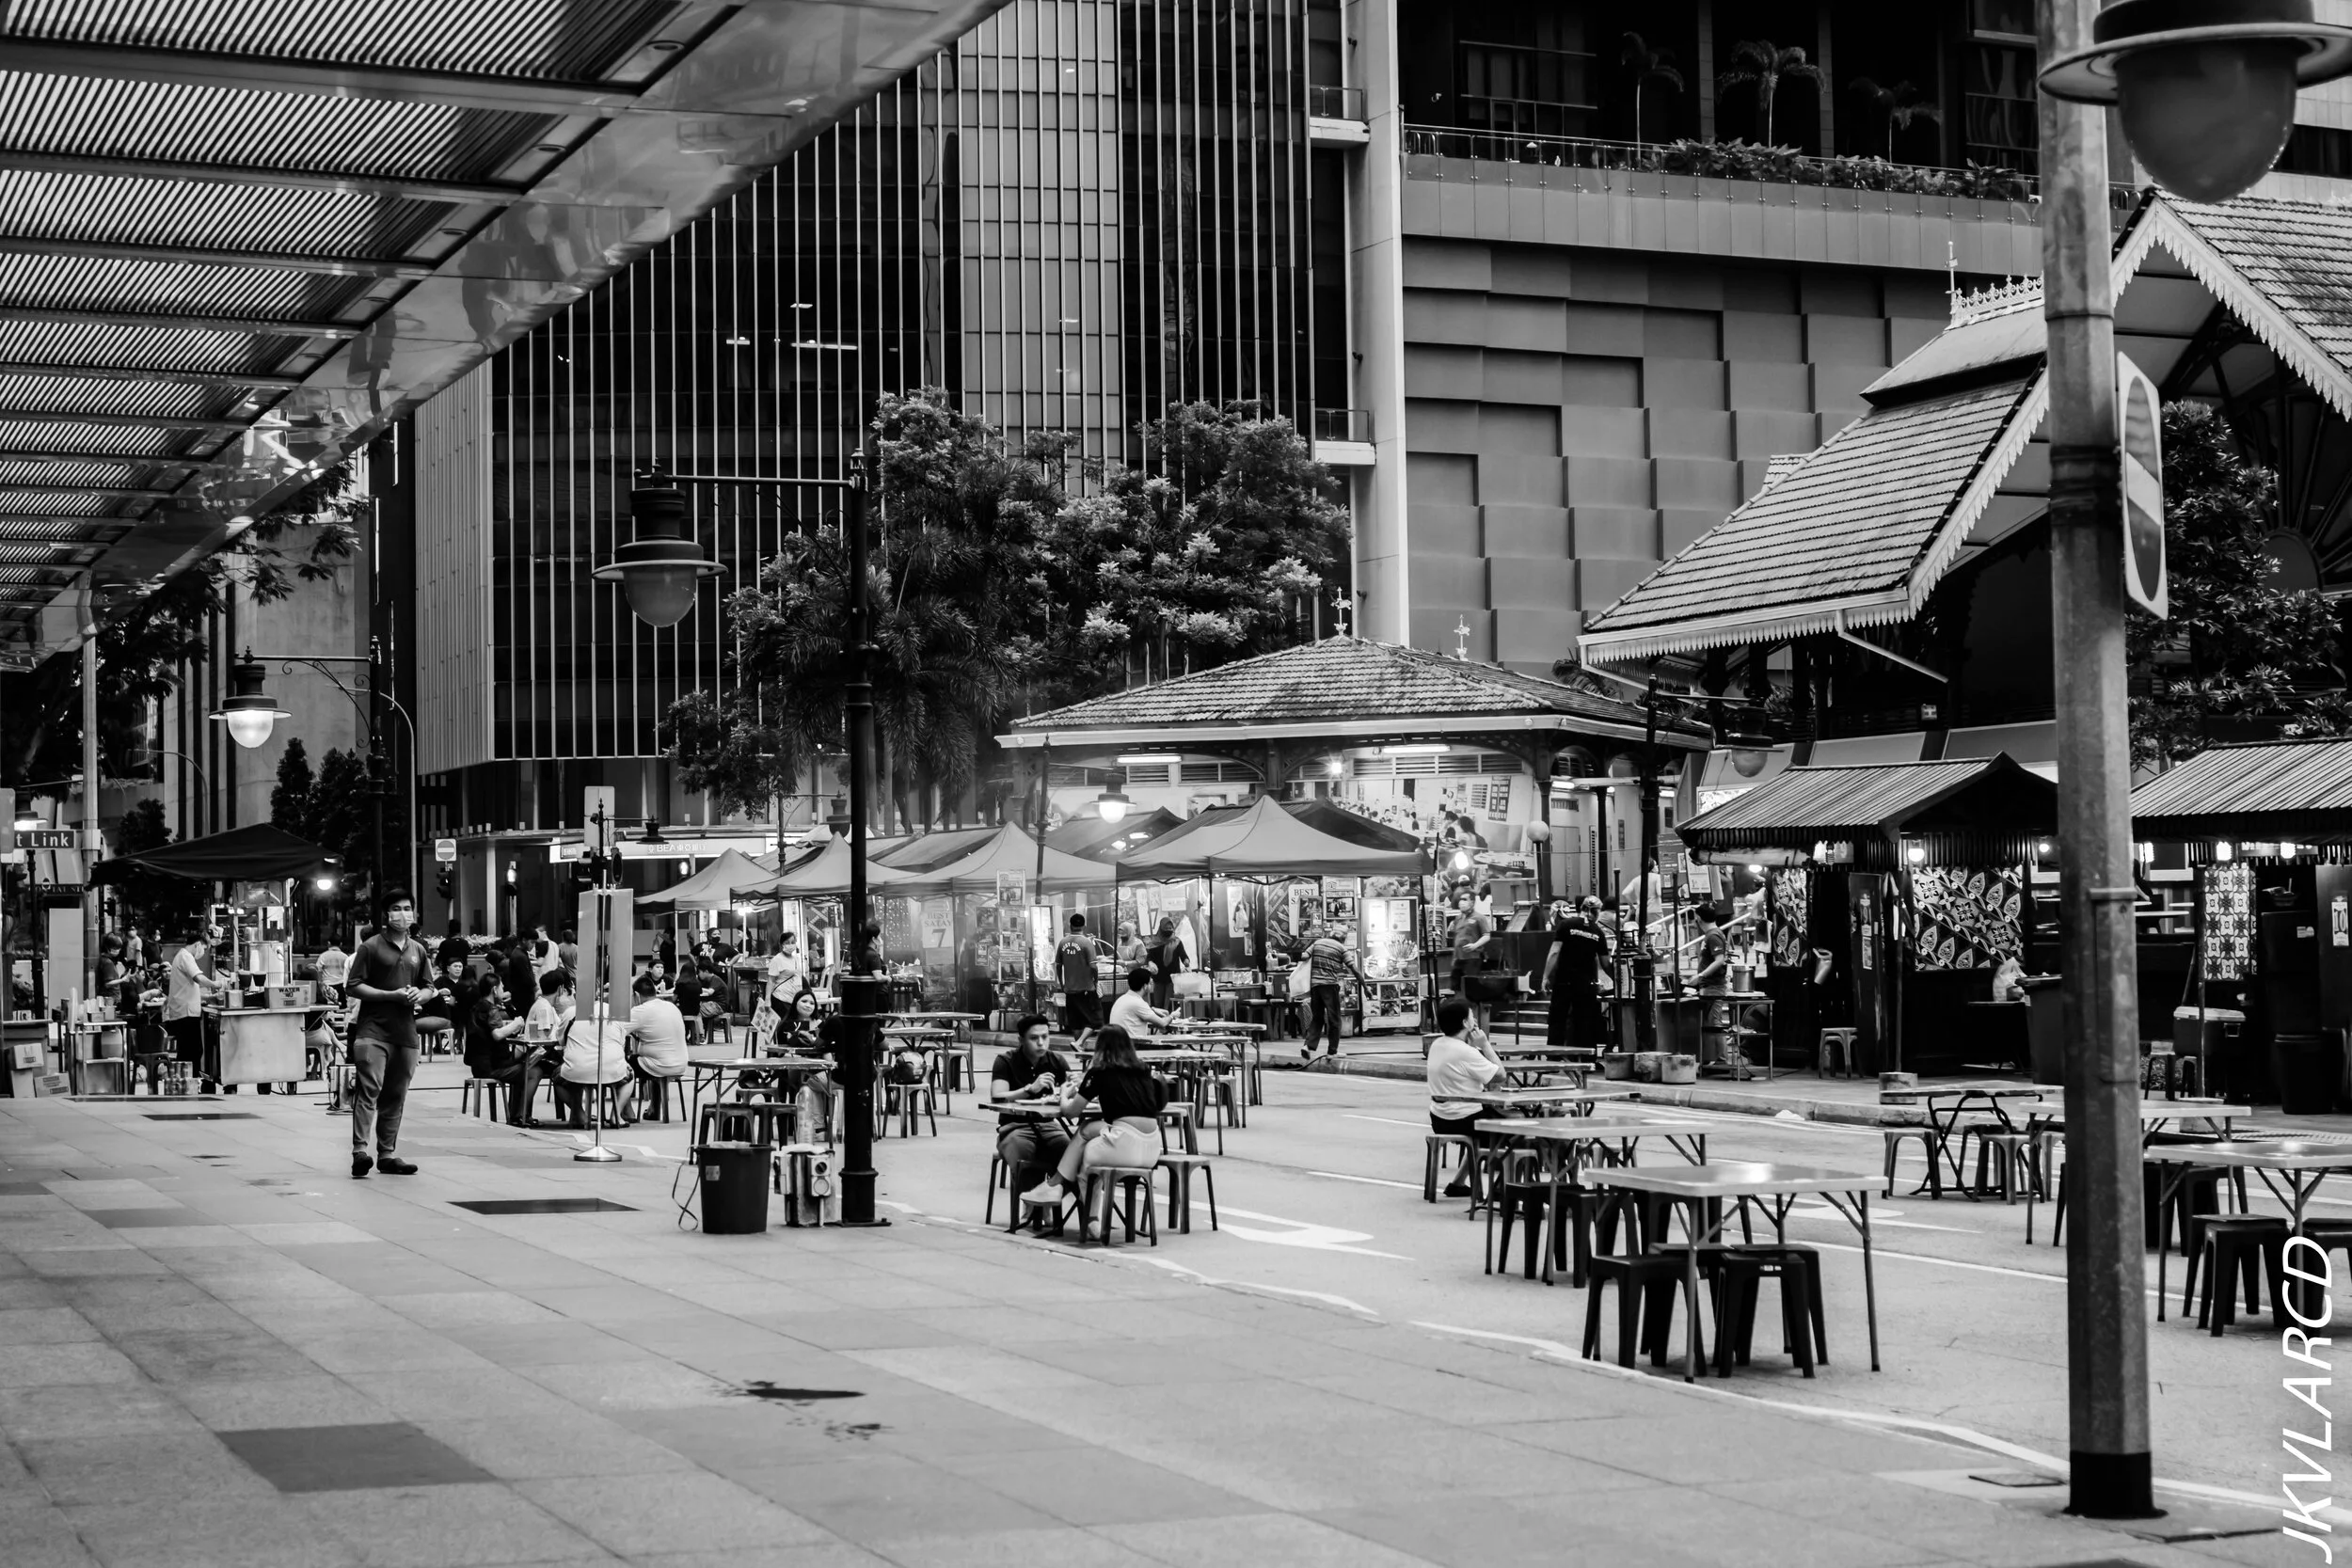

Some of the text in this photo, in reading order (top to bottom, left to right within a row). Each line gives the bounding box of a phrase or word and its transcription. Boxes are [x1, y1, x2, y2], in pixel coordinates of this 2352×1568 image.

[31, 832, 69, 847] Link
[1294, 888, 1314, 896] BEST
[932, 928, 946, 948] 7
